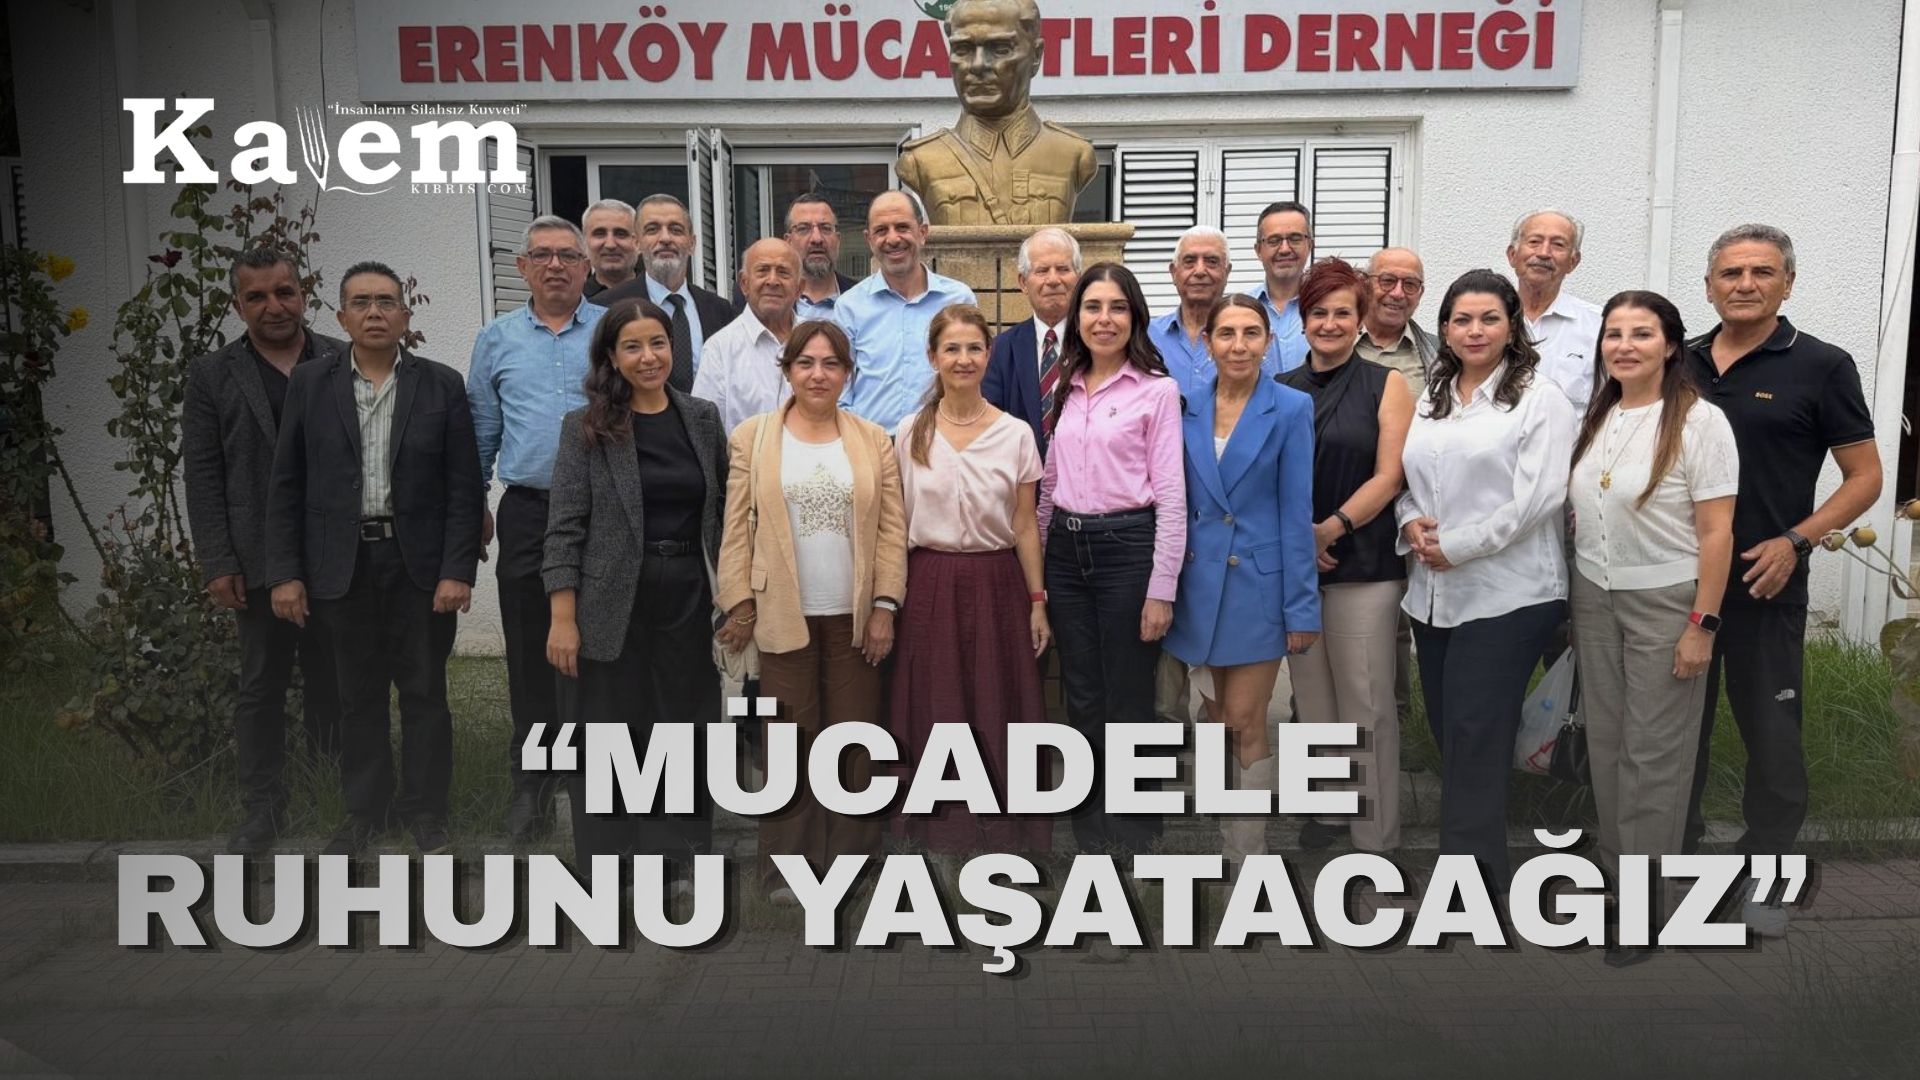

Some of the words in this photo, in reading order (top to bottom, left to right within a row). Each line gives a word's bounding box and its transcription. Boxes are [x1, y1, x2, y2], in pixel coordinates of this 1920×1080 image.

[399, 5, 728, 83] ERENKÖY
[745, 1, 1220, 82] MÜCATLERİ
[1242, 0, 1555, 74] DERNEĞİ
